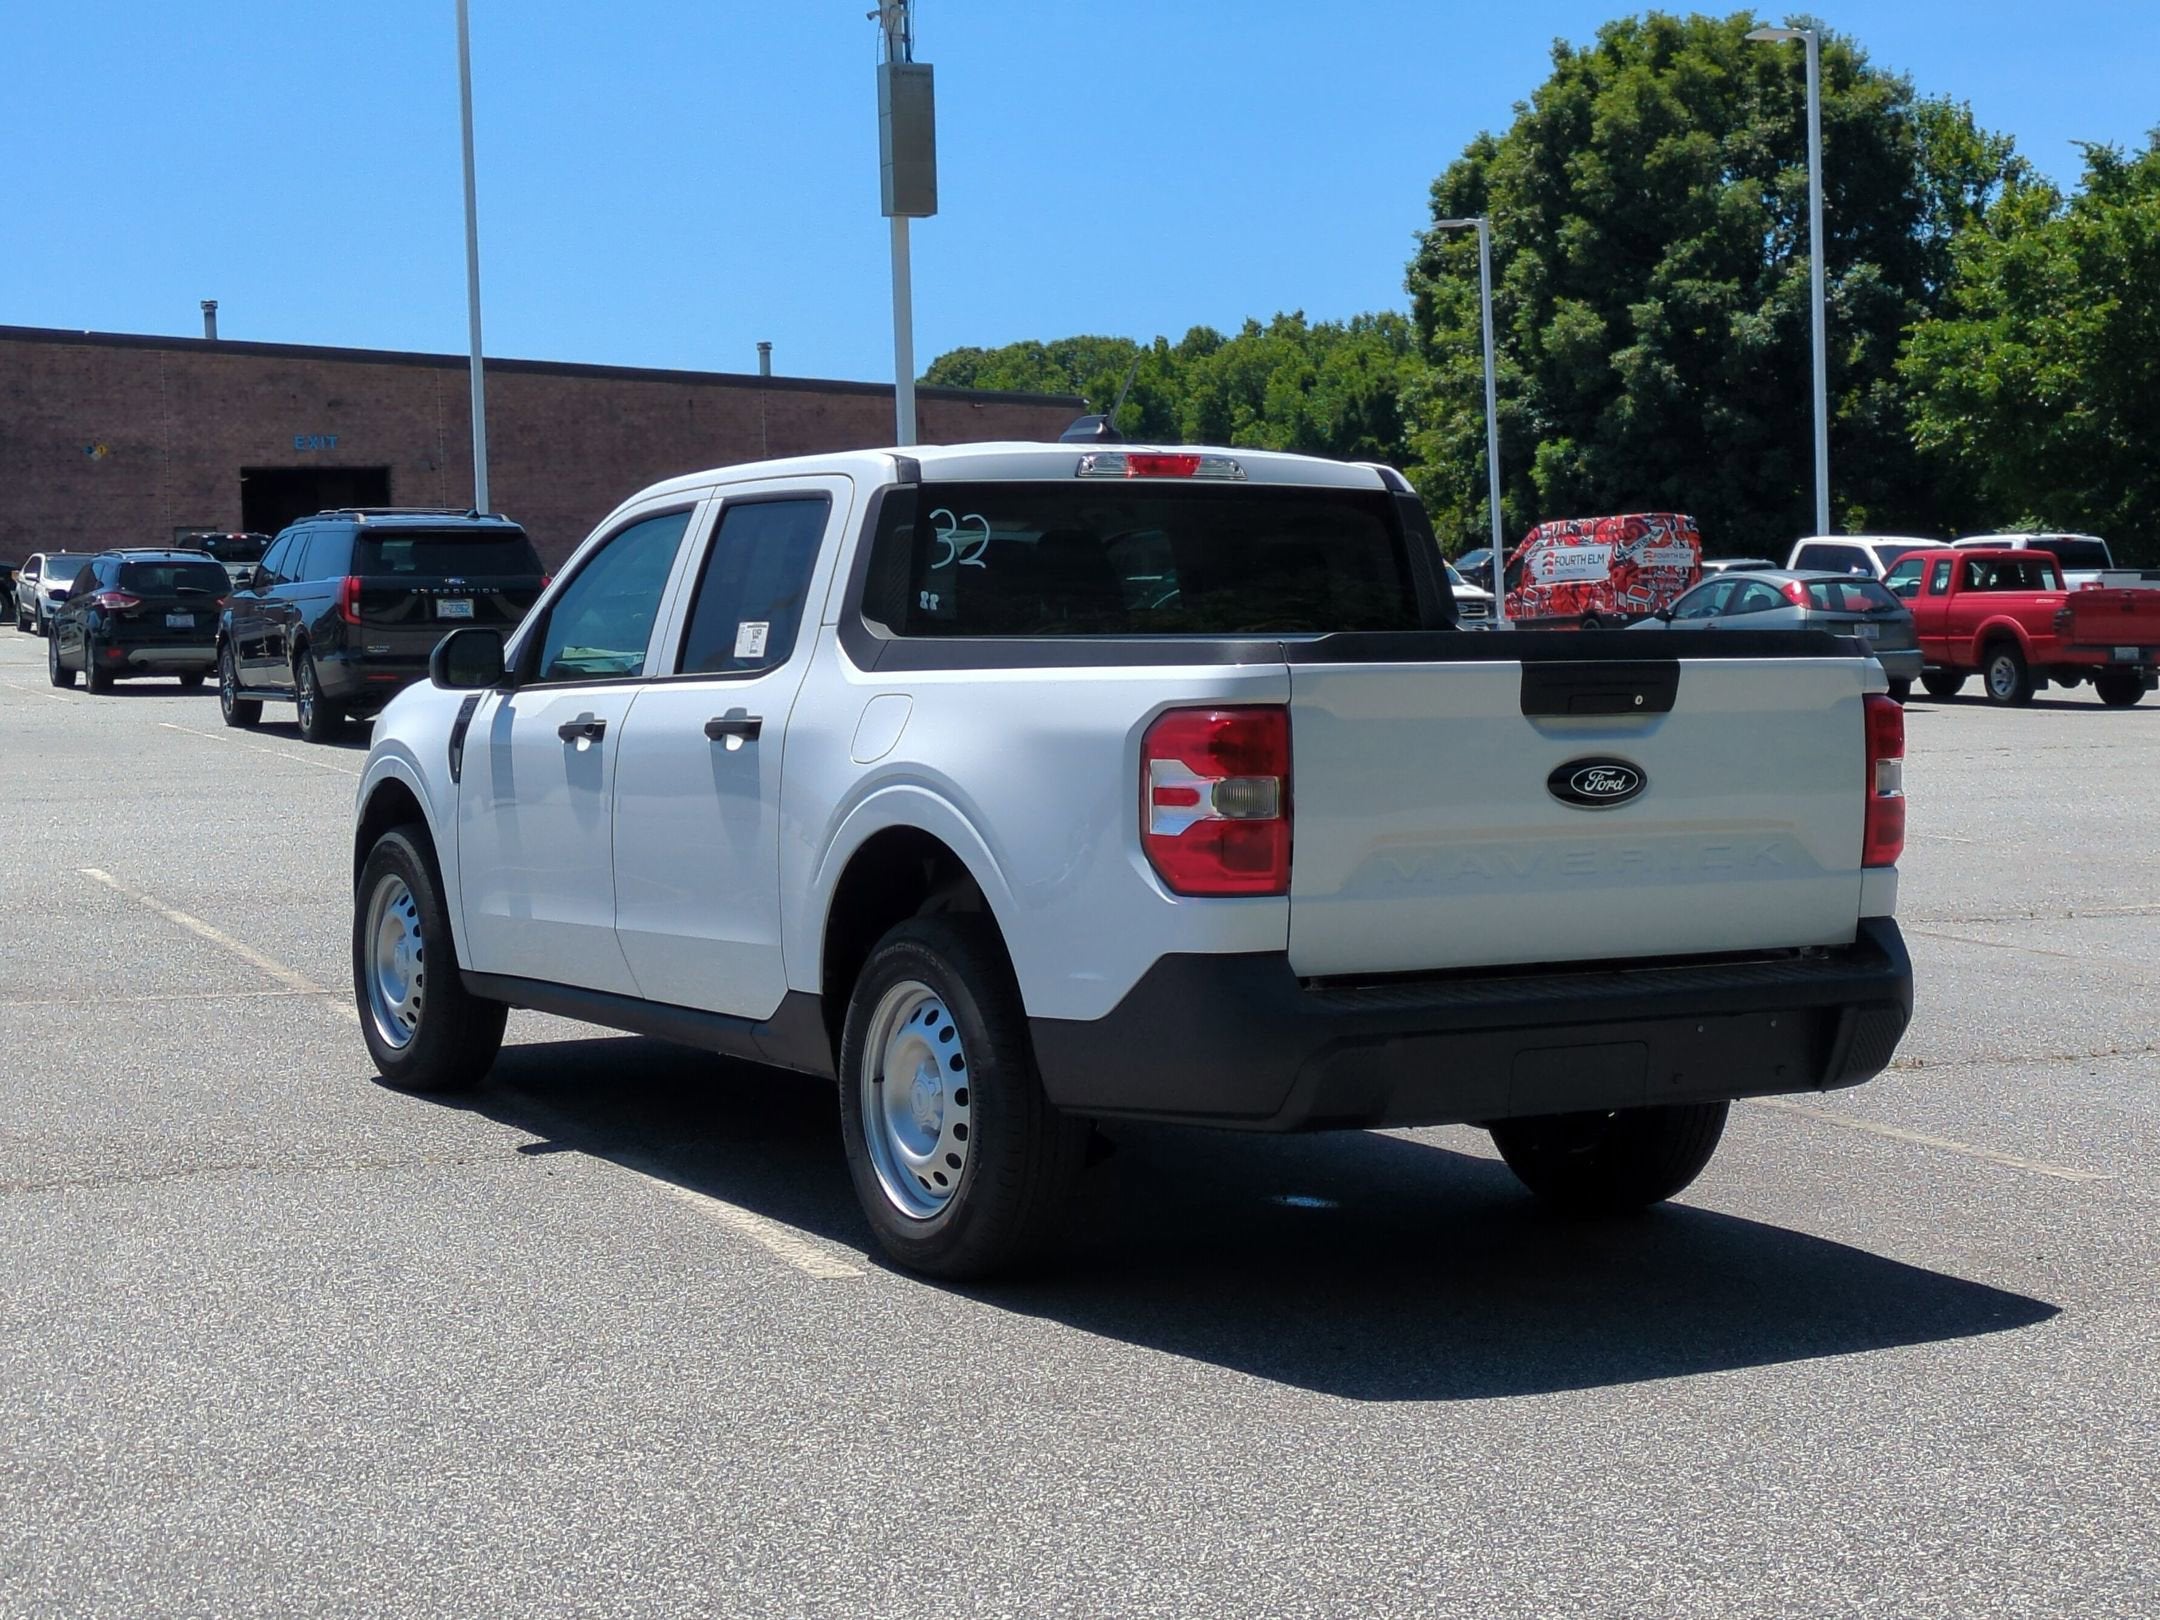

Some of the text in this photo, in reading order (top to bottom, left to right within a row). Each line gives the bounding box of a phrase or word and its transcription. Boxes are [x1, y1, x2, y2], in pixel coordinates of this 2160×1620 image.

[294, 435, 338, 449] EXIT
[929, 508, 991, 569] 32
[1554, 552, 1605, 566] FOURTH ELM
[1584, 769, 1626, 791] Ford
